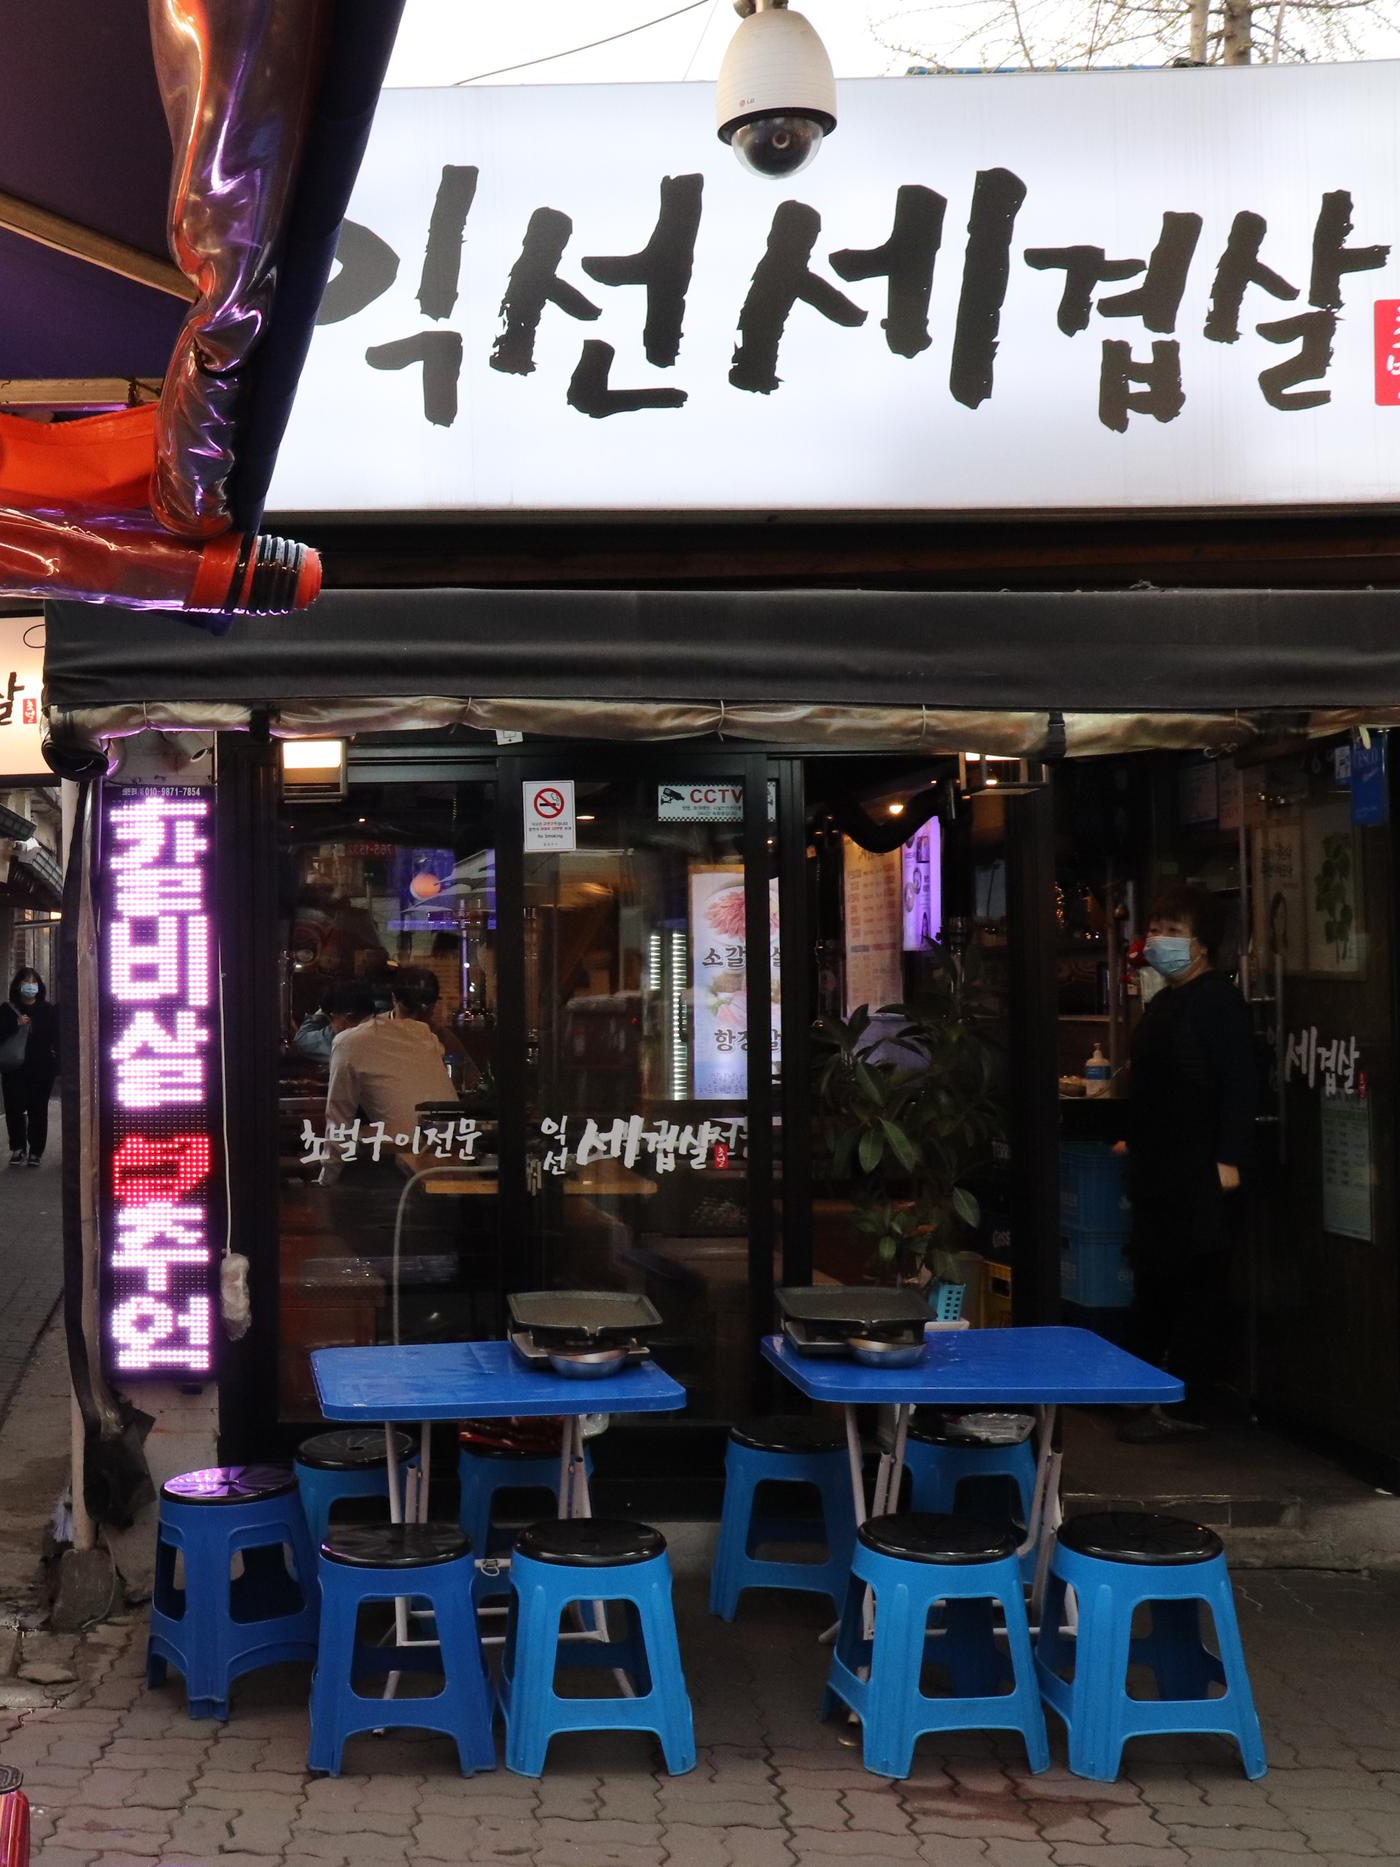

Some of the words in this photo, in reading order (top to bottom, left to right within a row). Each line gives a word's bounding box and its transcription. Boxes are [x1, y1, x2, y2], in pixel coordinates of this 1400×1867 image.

[144, 787, 200, 796] 010-9871-7854
[690, 789, 743, 803] CCTV
[1284, 1026, 1361, 1097] 세겹살
[576, 1115, 714, 1174] 세겹살
